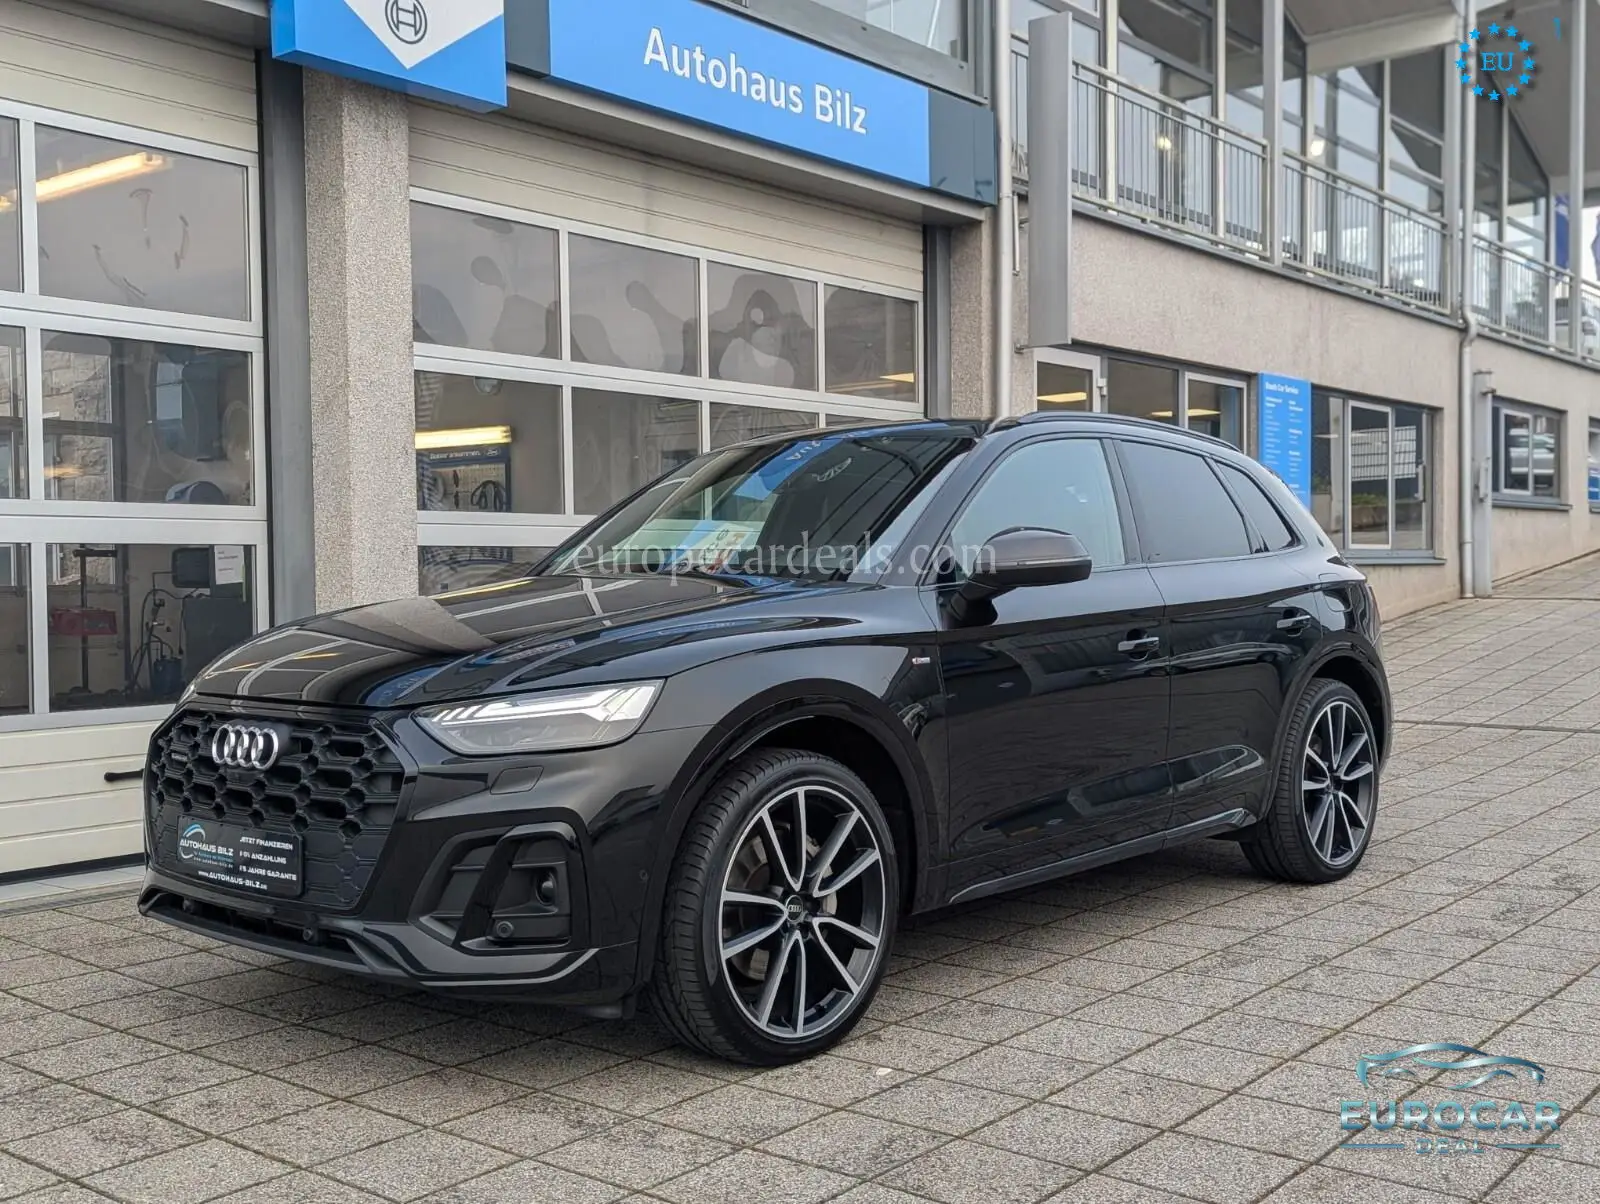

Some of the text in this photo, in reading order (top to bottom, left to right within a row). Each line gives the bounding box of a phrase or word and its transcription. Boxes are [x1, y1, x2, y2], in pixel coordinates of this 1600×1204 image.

[643, 26, 868, 135] Autohaus Bilz
[179, 838, 217, 853] AUTOHAUS
[217, 845, 234, 857] BILZ
